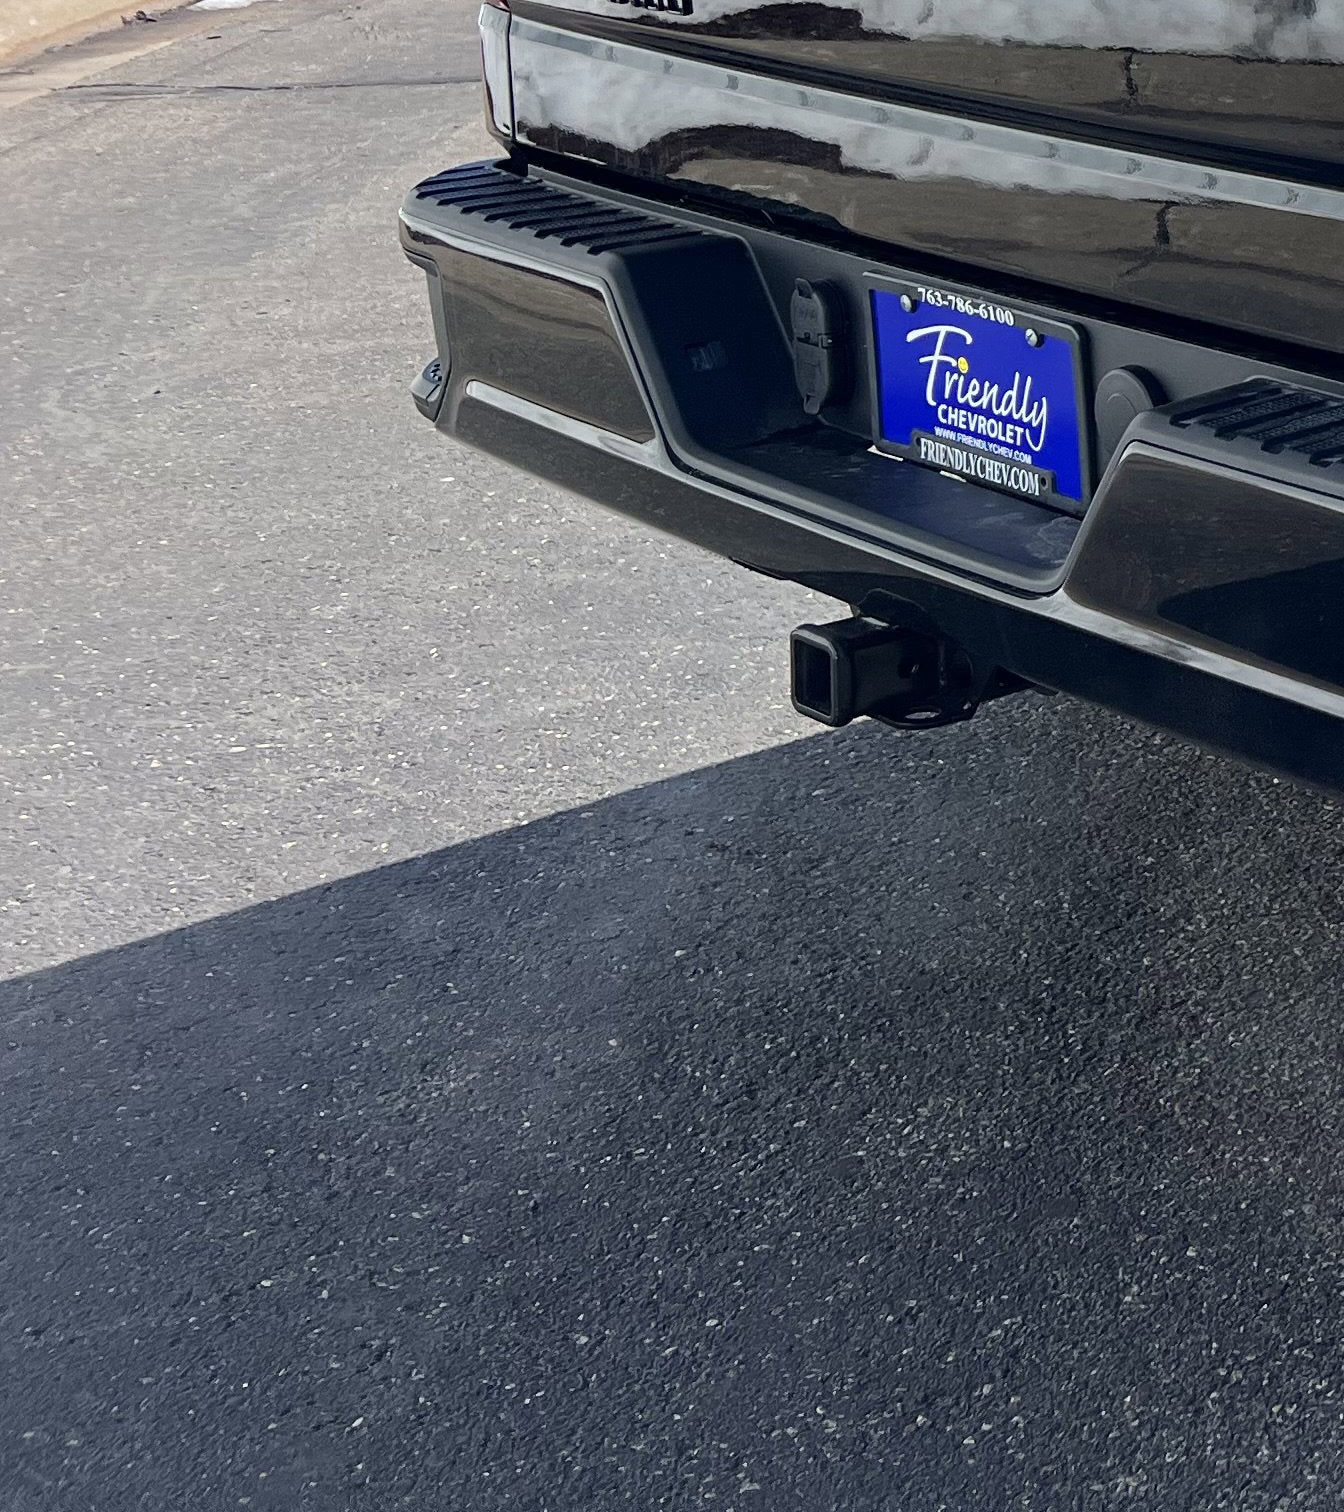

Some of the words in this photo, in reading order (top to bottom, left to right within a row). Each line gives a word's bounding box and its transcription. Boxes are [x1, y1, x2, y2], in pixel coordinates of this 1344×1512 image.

[917, 287, 1015, 327] 763-786-6100
[905, 325, 1049, 451] Friendly
[934, 425, 1032, 465] WWW.FRIENDLYCHEV.COM
[937, 402, 1024, 447] CHEVROLET
[919, 436, 1040, 496] FRIENDLYCHEV.COM
